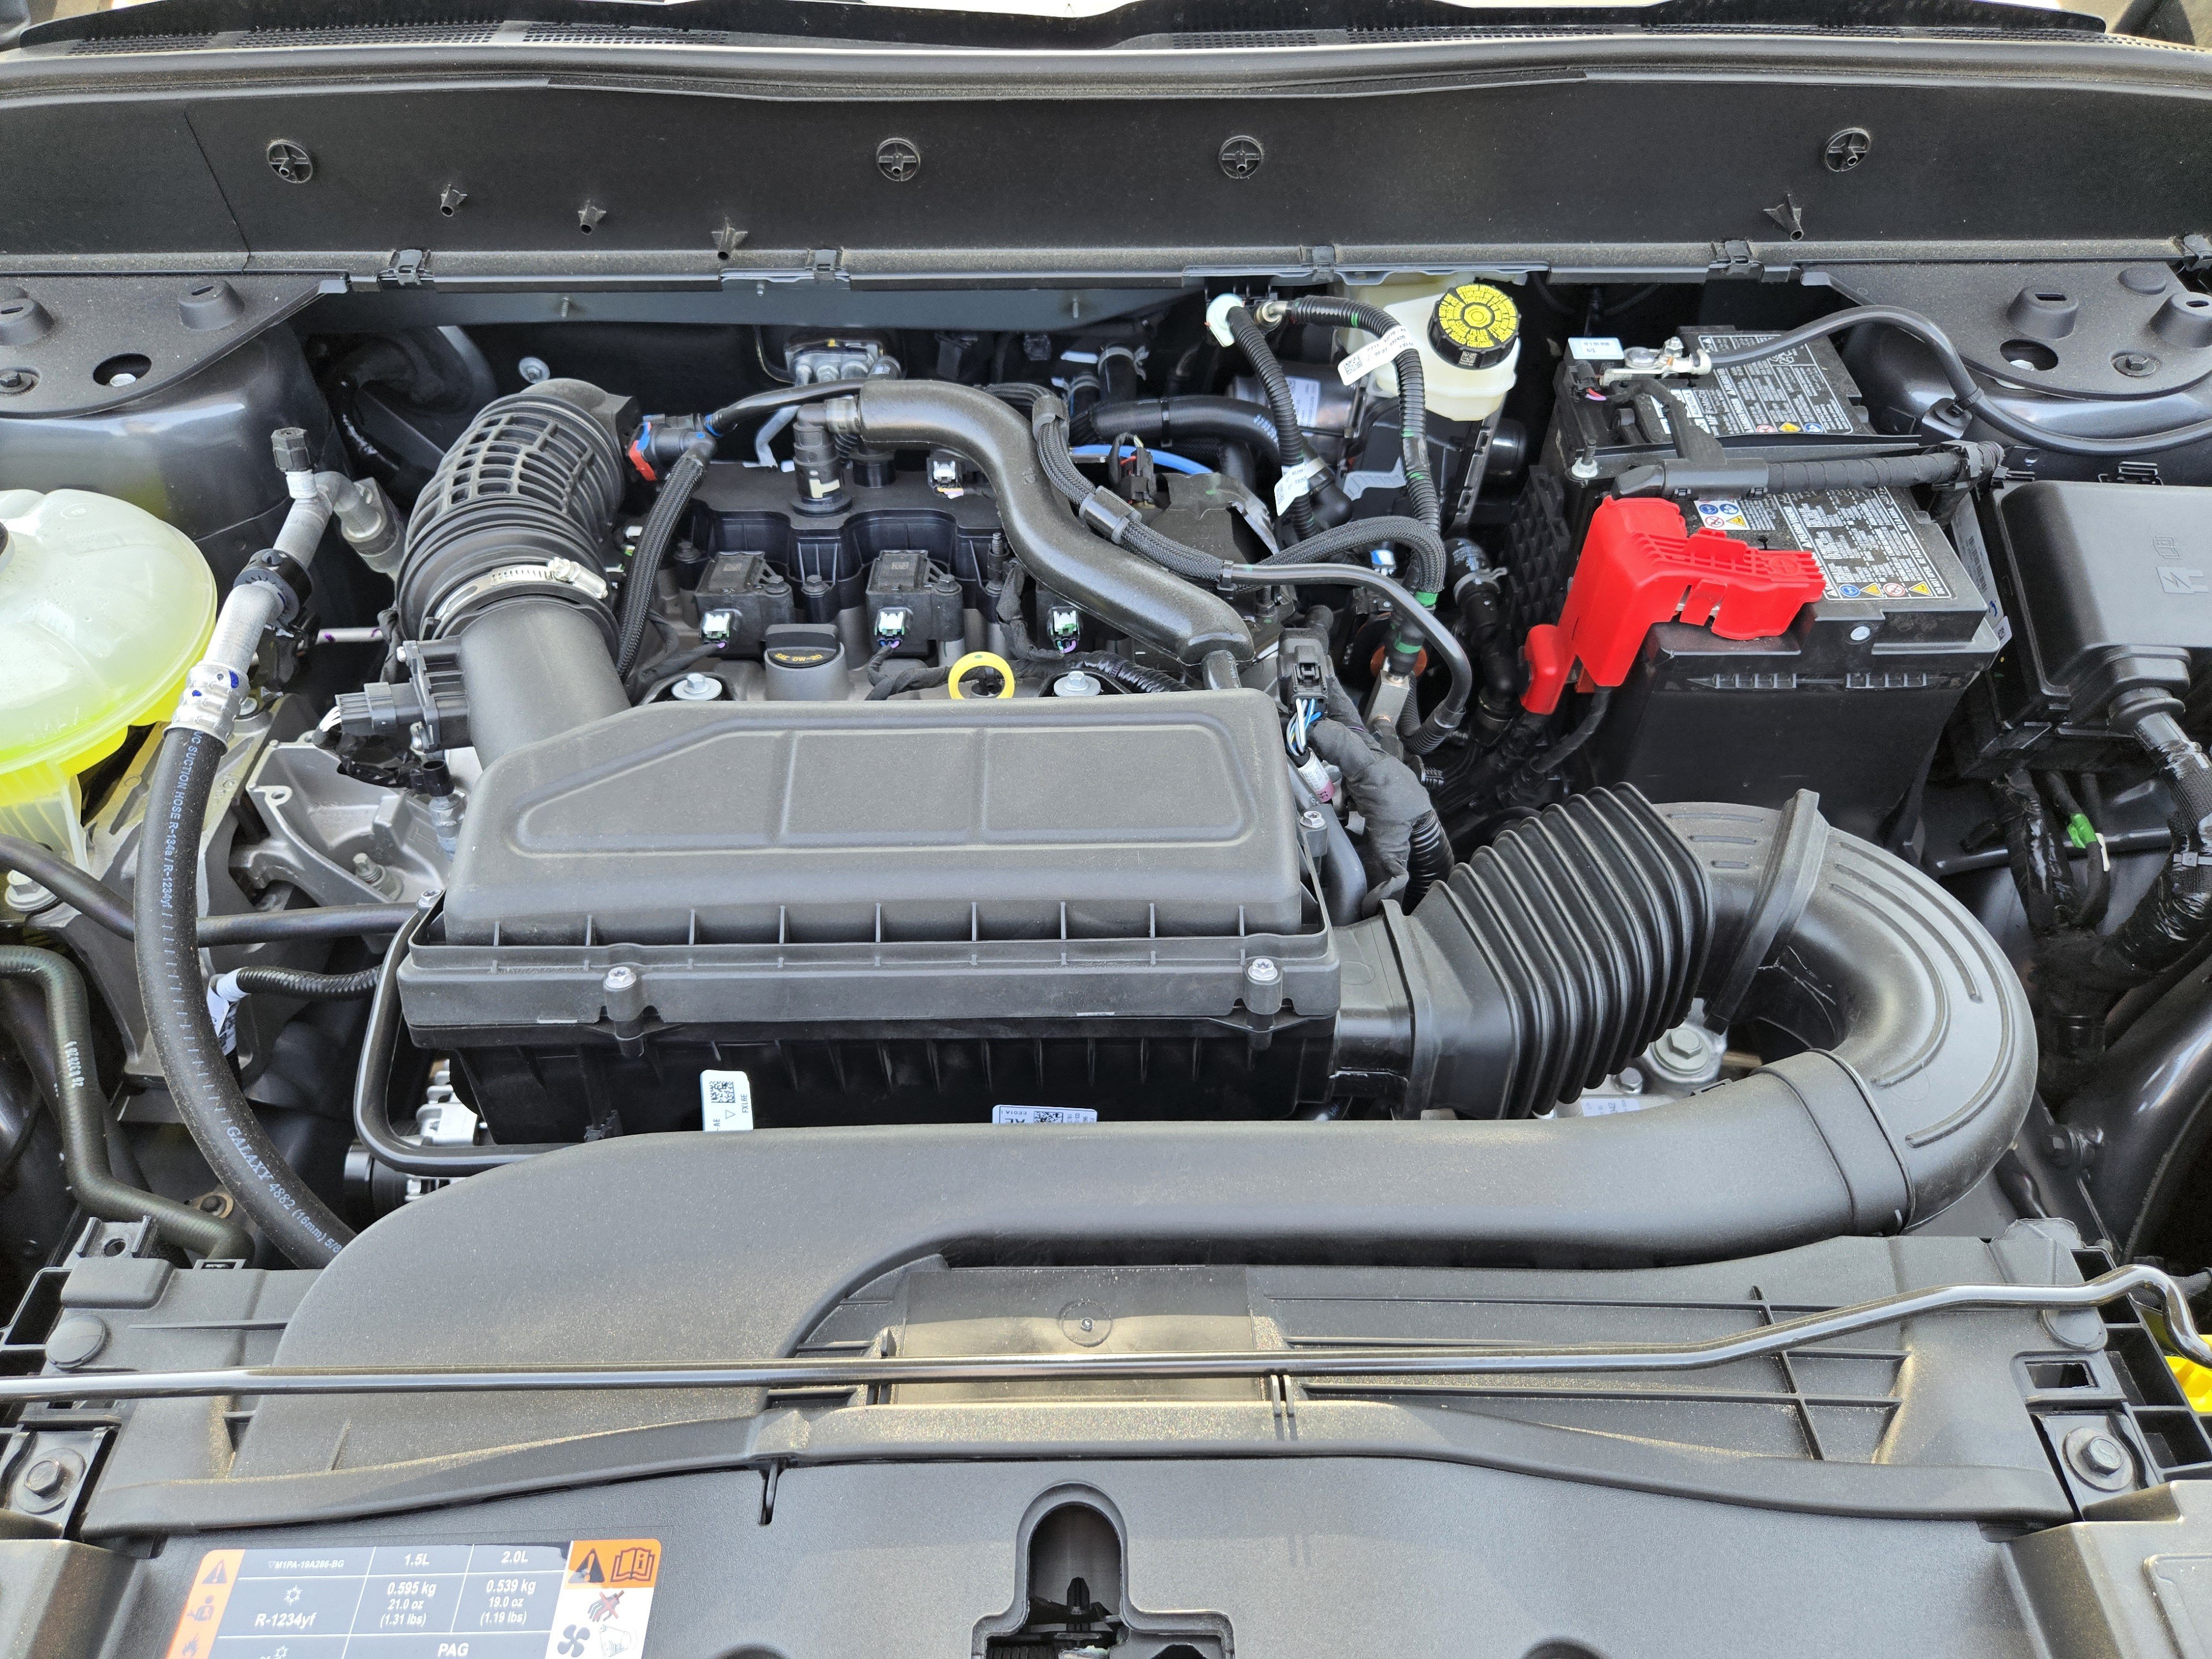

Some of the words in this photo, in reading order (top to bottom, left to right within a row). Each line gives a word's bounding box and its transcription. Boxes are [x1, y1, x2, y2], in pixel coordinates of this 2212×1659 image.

[178, 745, 198, 789] SUCTION
[169, 791, 185, 820] HOSE
[165, 822, 179, 856] R-134a
[161, 864, 174, 909] R-1234yf
[740, 1094, 749, 1113] FXL6E
[227, 1126, 274, 1180] GALAXY
[270, 1183, 295, 1210] 4882
[292, 1209, 327, 1242] (16mm)
[325, 1238, 342, 1253] 5/8
[274, 1559, 345, 1569] M1PA-19A286-BG
[404, 1553, 430, 1566] 1.5L
[501, 1551, 529, 1563] 2.0L
[387, 1582, 420, 1595] 0.595
[421, 1582, 437, 1598] kg
[486, 1579, 519, 1593] 0.539
[520, 1578, 536, 1595] kg
[388, 1598, 410, 1610] 21.0
[411, 1600, 425, 1609] oz
[489, 1596, 510, 1608] 19.0
[512, 1598, 524, 1607] oz
[254, 1612, 317, 1629] R-1234yf
[380, 1614, 405, 1628] (1.31
[407, 1613, 426, 1627] lbs)
[480, 1611, 505, 1627] (1.19
[507, 1610, 526, 1625] lbs)
[437, 1642, 469, 1657] PAG
